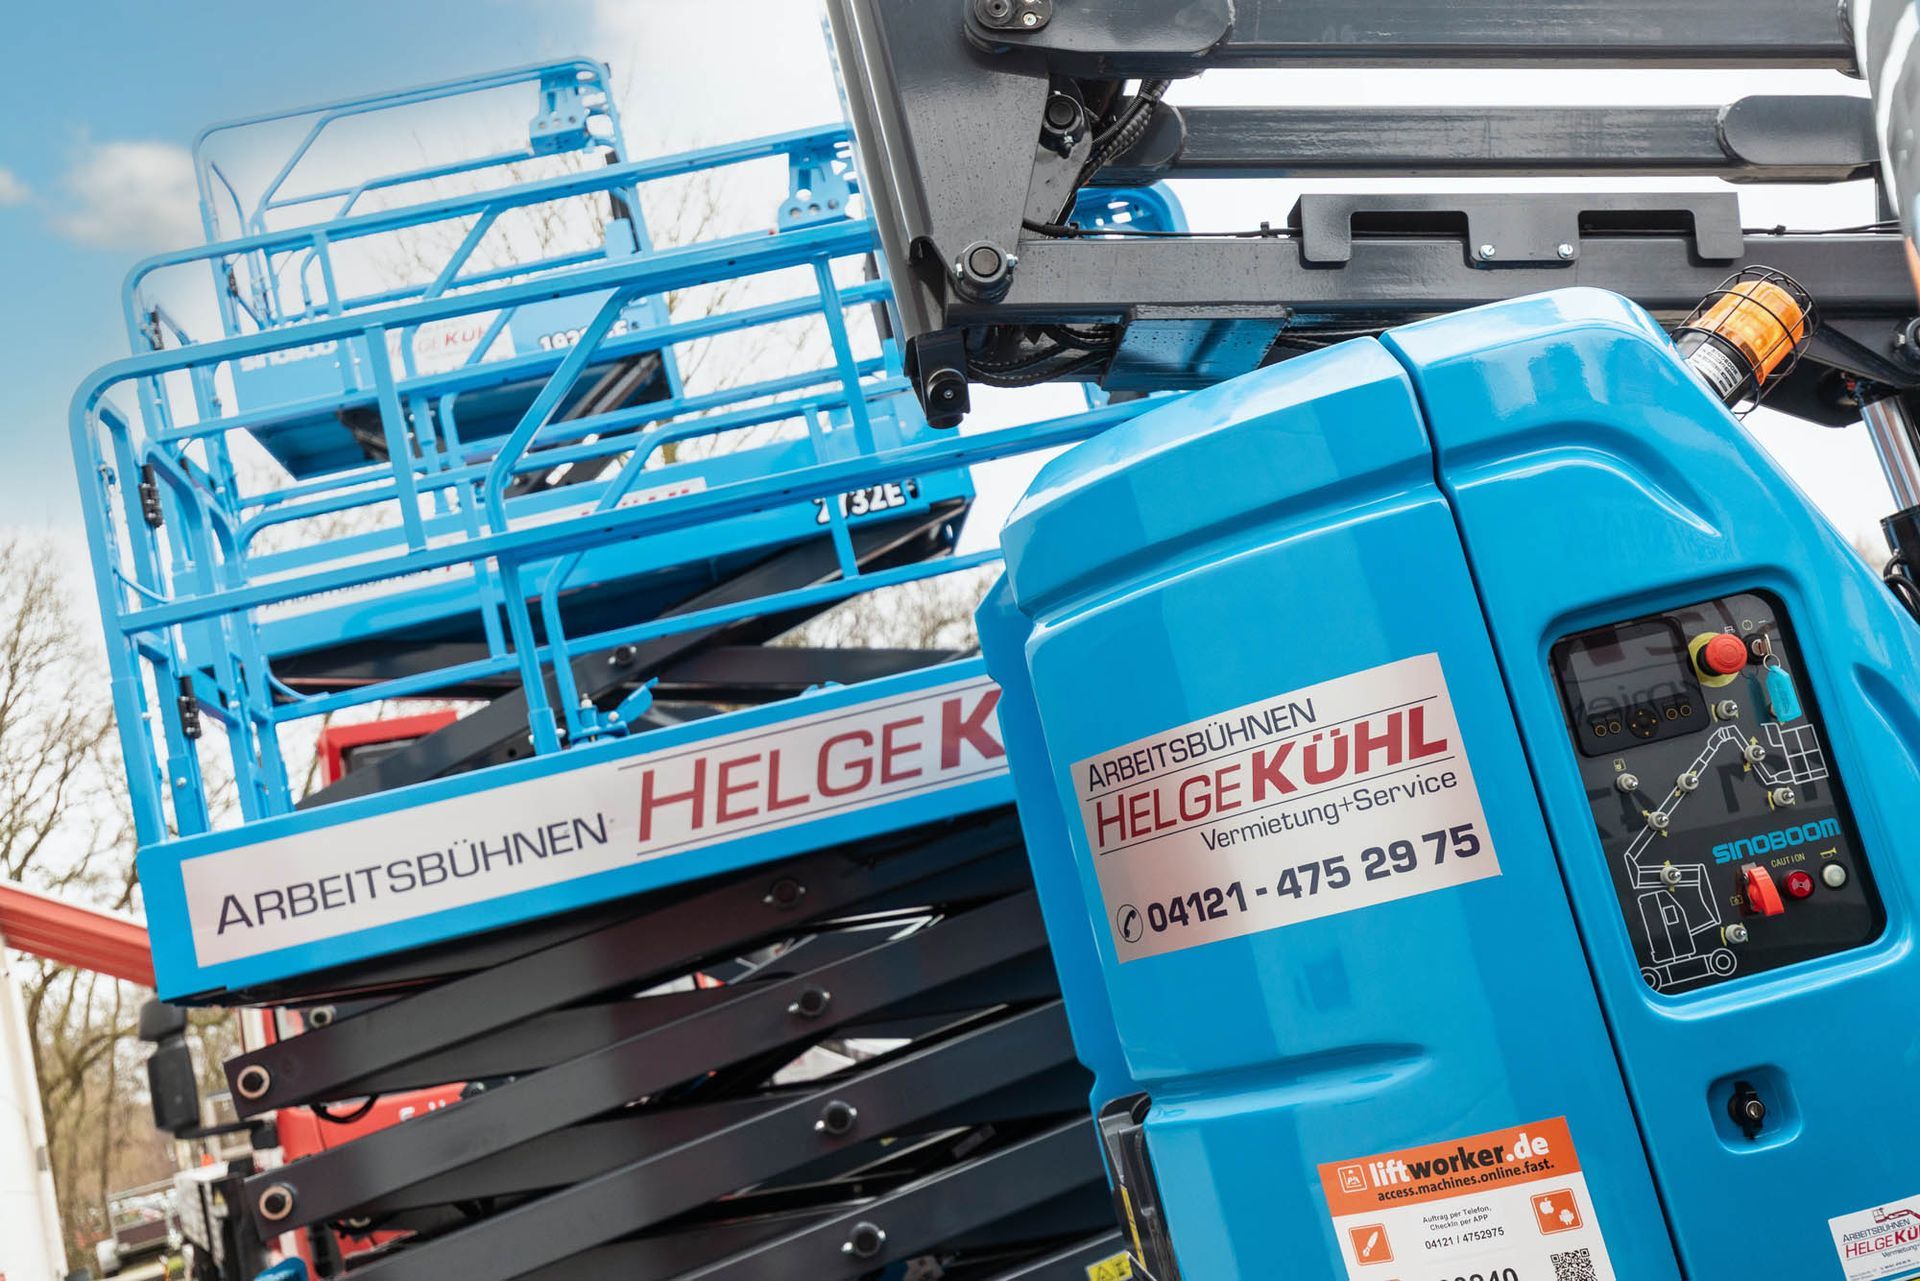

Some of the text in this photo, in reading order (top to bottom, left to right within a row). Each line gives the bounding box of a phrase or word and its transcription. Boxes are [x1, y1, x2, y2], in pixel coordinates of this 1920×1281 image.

[1089, 697, 1318, 792] ARBEITSBÜHNEN
[1200, 771, 1458, 851] Vermietung+Service
[216, 812, 608, 936] ARBEITSBÜHNEN
[1147, 881, 1249, 932] 04121
[1276, 855, 1351, 899] 475
[1360, 839, 1418, 882] 29
[1421, 822, 1481, 866] 75
[1770, 852, 1806, 868] CAUTION
[1368, 1132, 1550, 1188] liftworker.de
[1377, 1158, 1555, 1202] access.machines.online.fast.
[1422, 1213, 1449, 1224] Auftrag
[1449, 1211, 1462, 1219] per
[1424, 1236, 1454, 1250] 04121
[1462, 1226, 1505, 1243] 4752975
[1459, 1218, 1471, 1226] per
[1473, 1213, 1489, 1223] APP
[1894, 1224, 1920, 1245] KÜ
